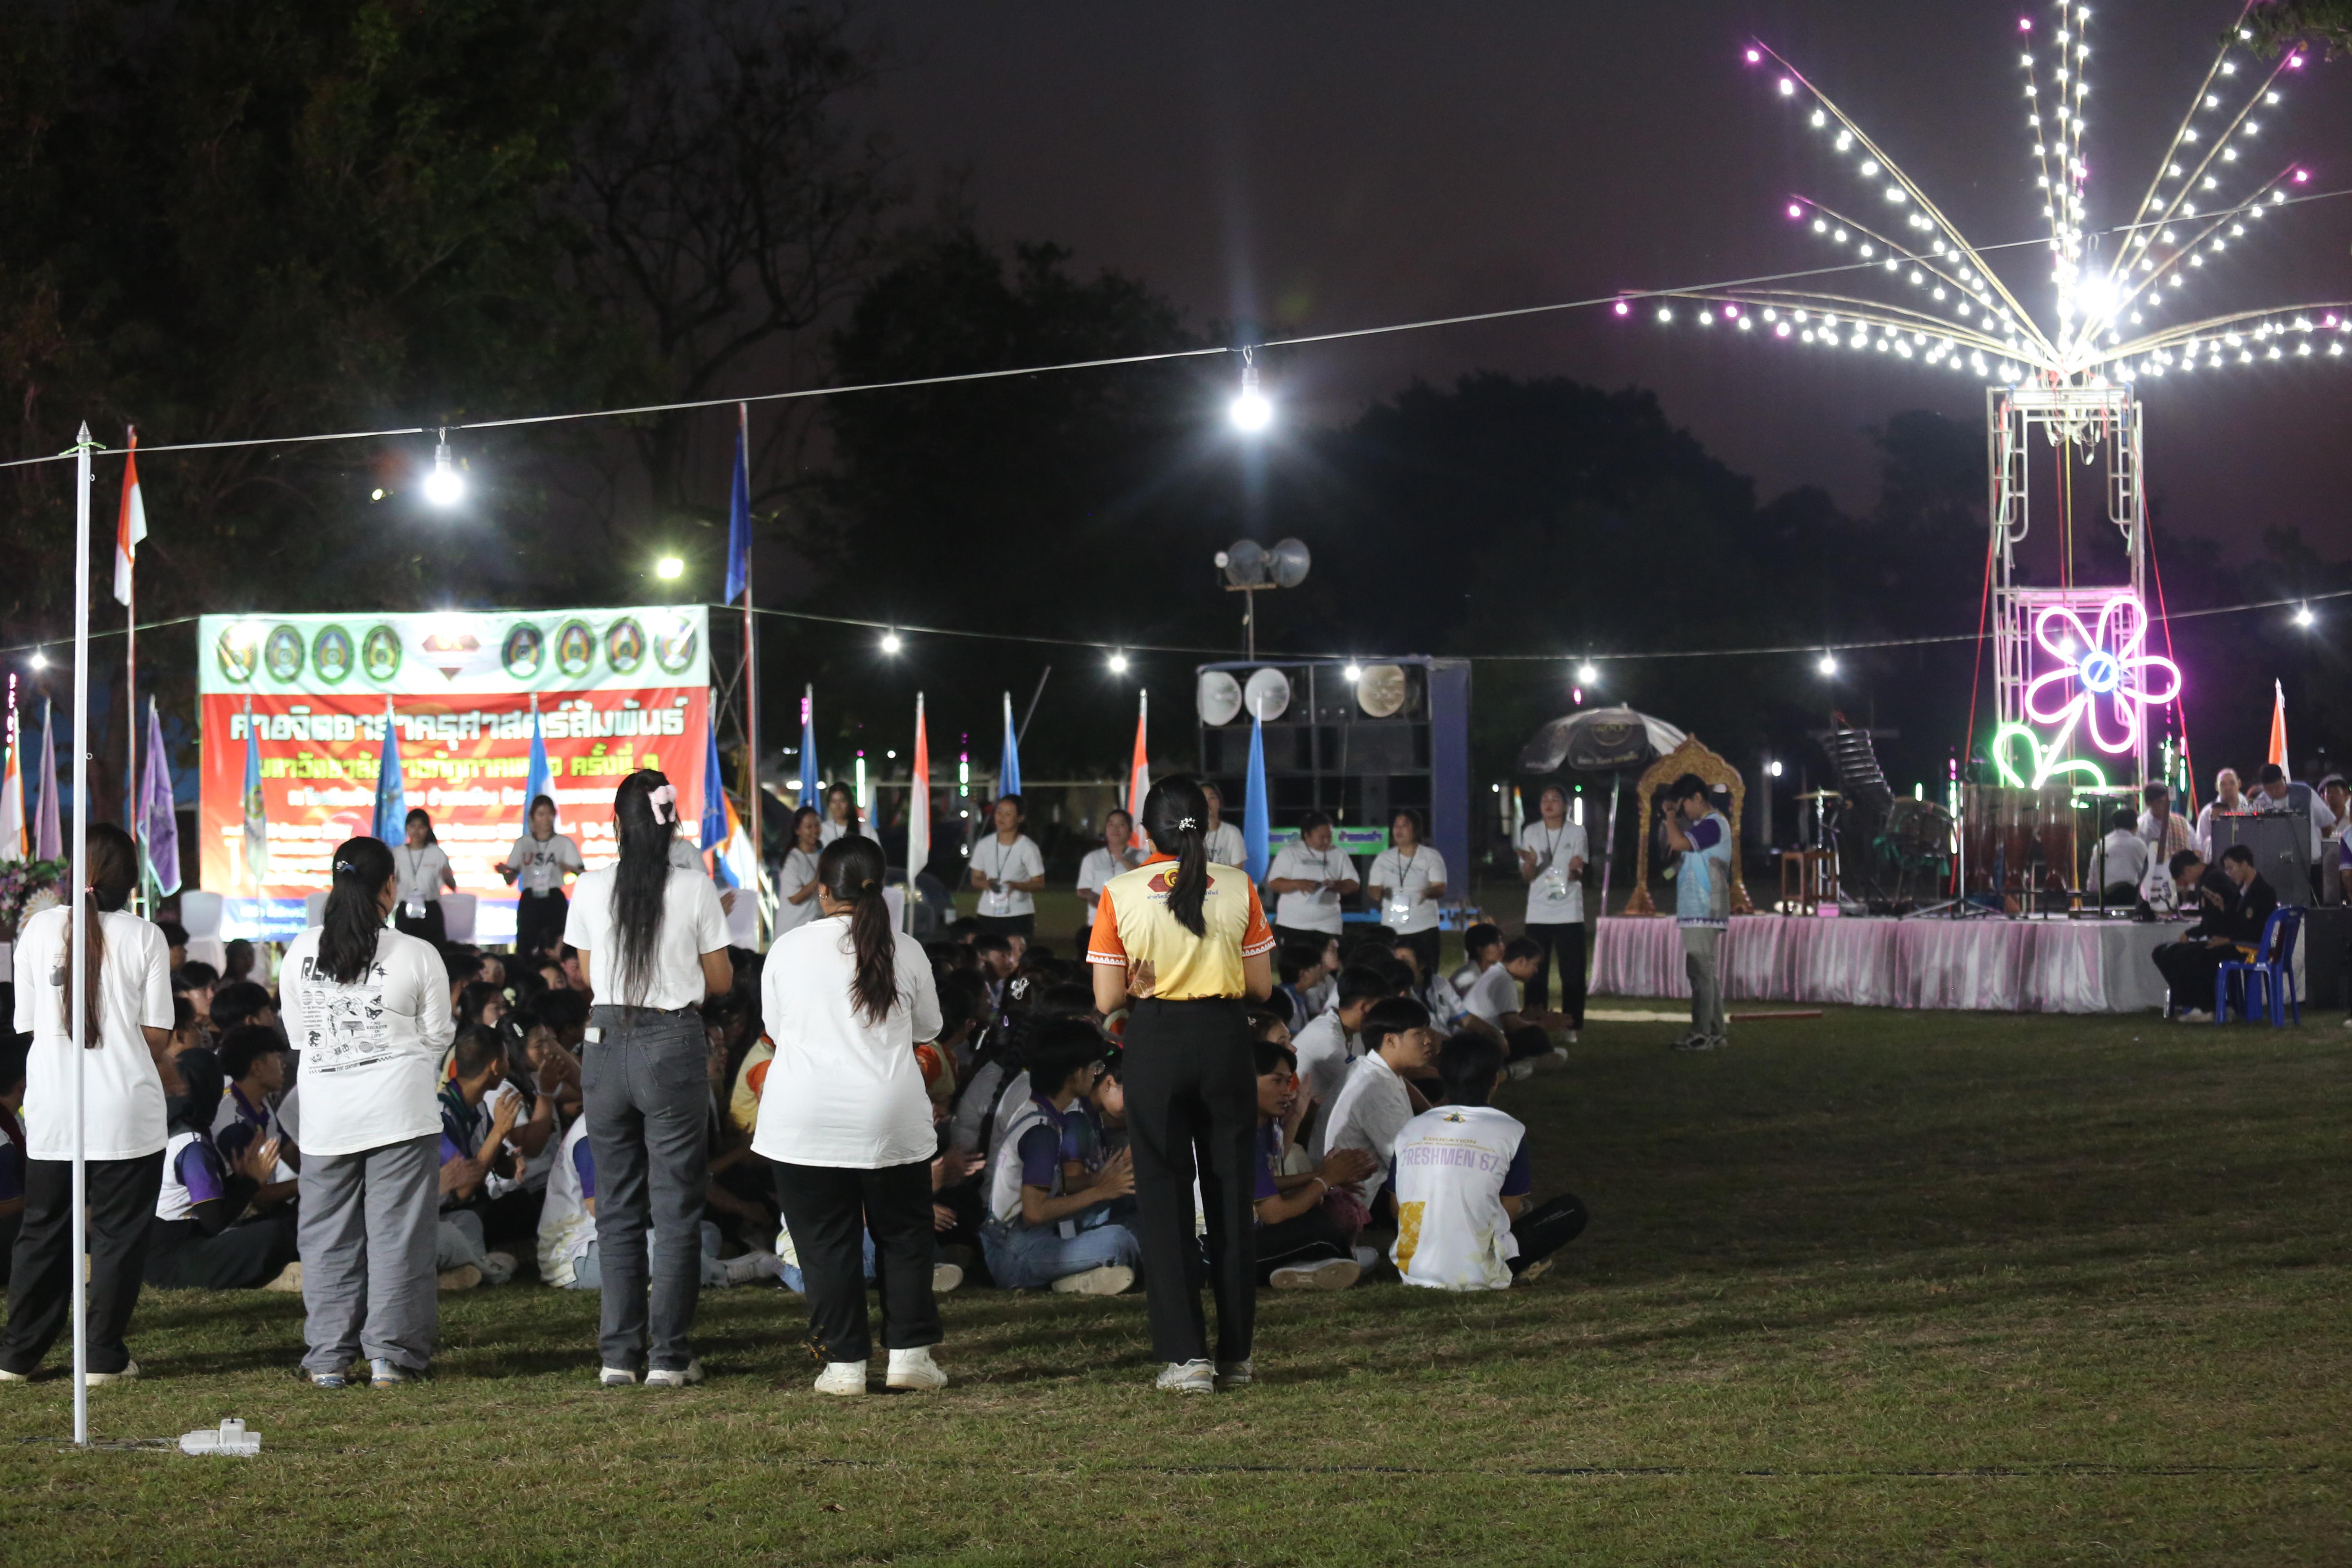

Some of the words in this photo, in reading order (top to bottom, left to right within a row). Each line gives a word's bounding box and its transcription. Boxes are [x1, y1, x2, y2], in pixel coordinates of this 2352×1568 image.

[231, 696, 689, 751] คายจิตอาสาครุศาสตร์สัมพันธ์
[258, 750, 563, 784] มหาวิทยาลัยาชภัฏภาคเหอ
[571, 742, 634, 776] ครั้งที่
[523, 852, 557, 866] USA
[1402, 1147, 1476, 1168] FRESHMEN
[1479, 1153, 1501, 1173] 67
